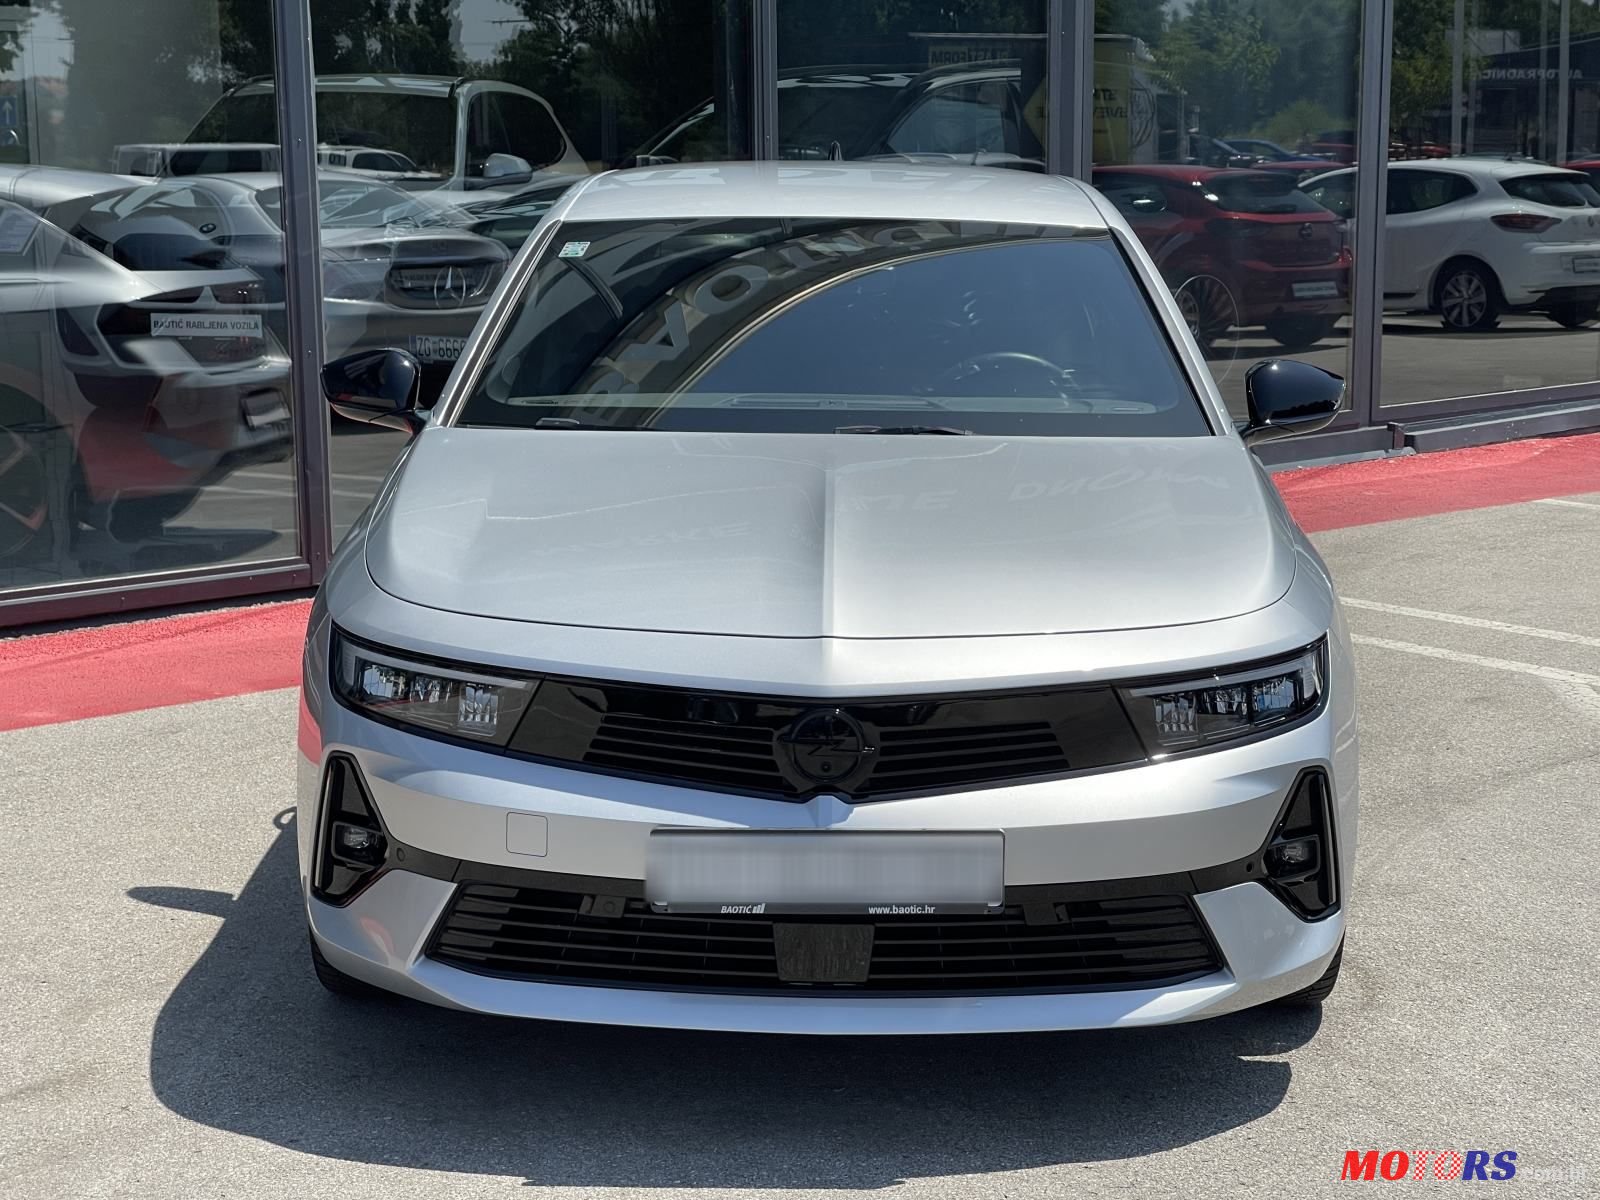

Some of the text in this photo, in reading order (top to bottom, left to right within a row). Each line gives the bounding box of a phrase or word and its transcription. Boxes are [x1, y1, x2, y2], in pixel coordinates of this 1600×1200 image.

[186, 320, 228, 330] RABLJENA
[230, 320, 260, 331] VOZILA
[416, 337, 431, 357] ZG
[720, 904, 752, 915] BAOTIĆ
[868, 904, 936, 915] www.baotic.hr
